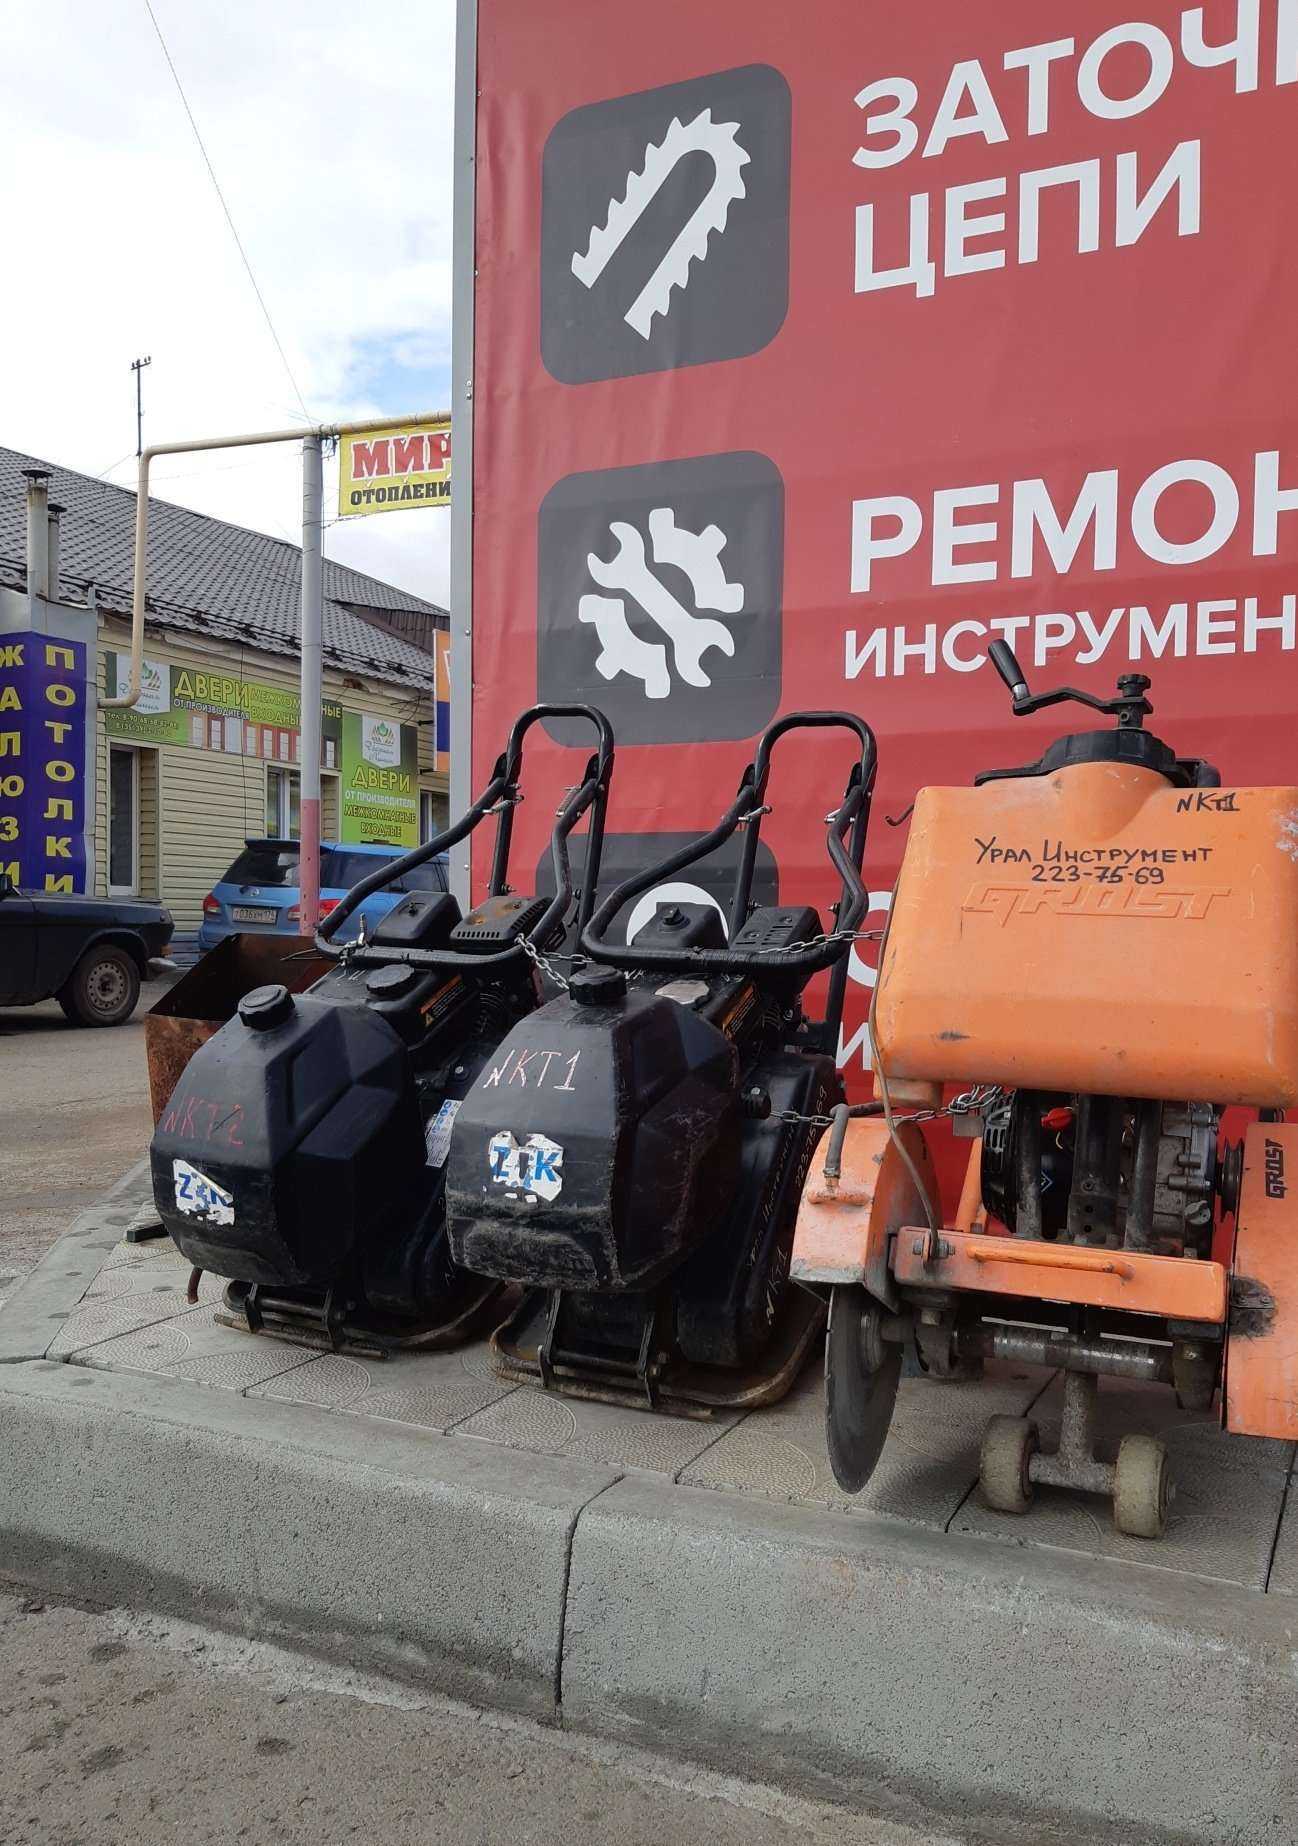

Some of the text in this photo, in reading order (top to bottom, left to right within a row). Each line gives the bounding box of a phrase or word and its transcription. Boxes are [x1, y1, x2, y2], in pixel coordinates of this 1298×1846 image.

[853, 139, 1201, 298] ЦЕПИ
[351, 430, 451, 480] МИР
[350, 481, 451, 506] ОТОПЛЕНИ
[174, 671, 250, 708] ДВЕРИ
[43, 644, 77, 894] ПОТОЛКИ
[351, 765, 411, 794] ДВЕРИ
[344, 790, 355, 800] ОТ
[344, 804, 417, 825] МЕЖКОМНАТНЫЕ
[360, 822, 402, 838] ВХОДНЫЕ
[1031, 863, 1166, 885] 223-75-69
[1264, 1138, 1289, 1200] GROST
